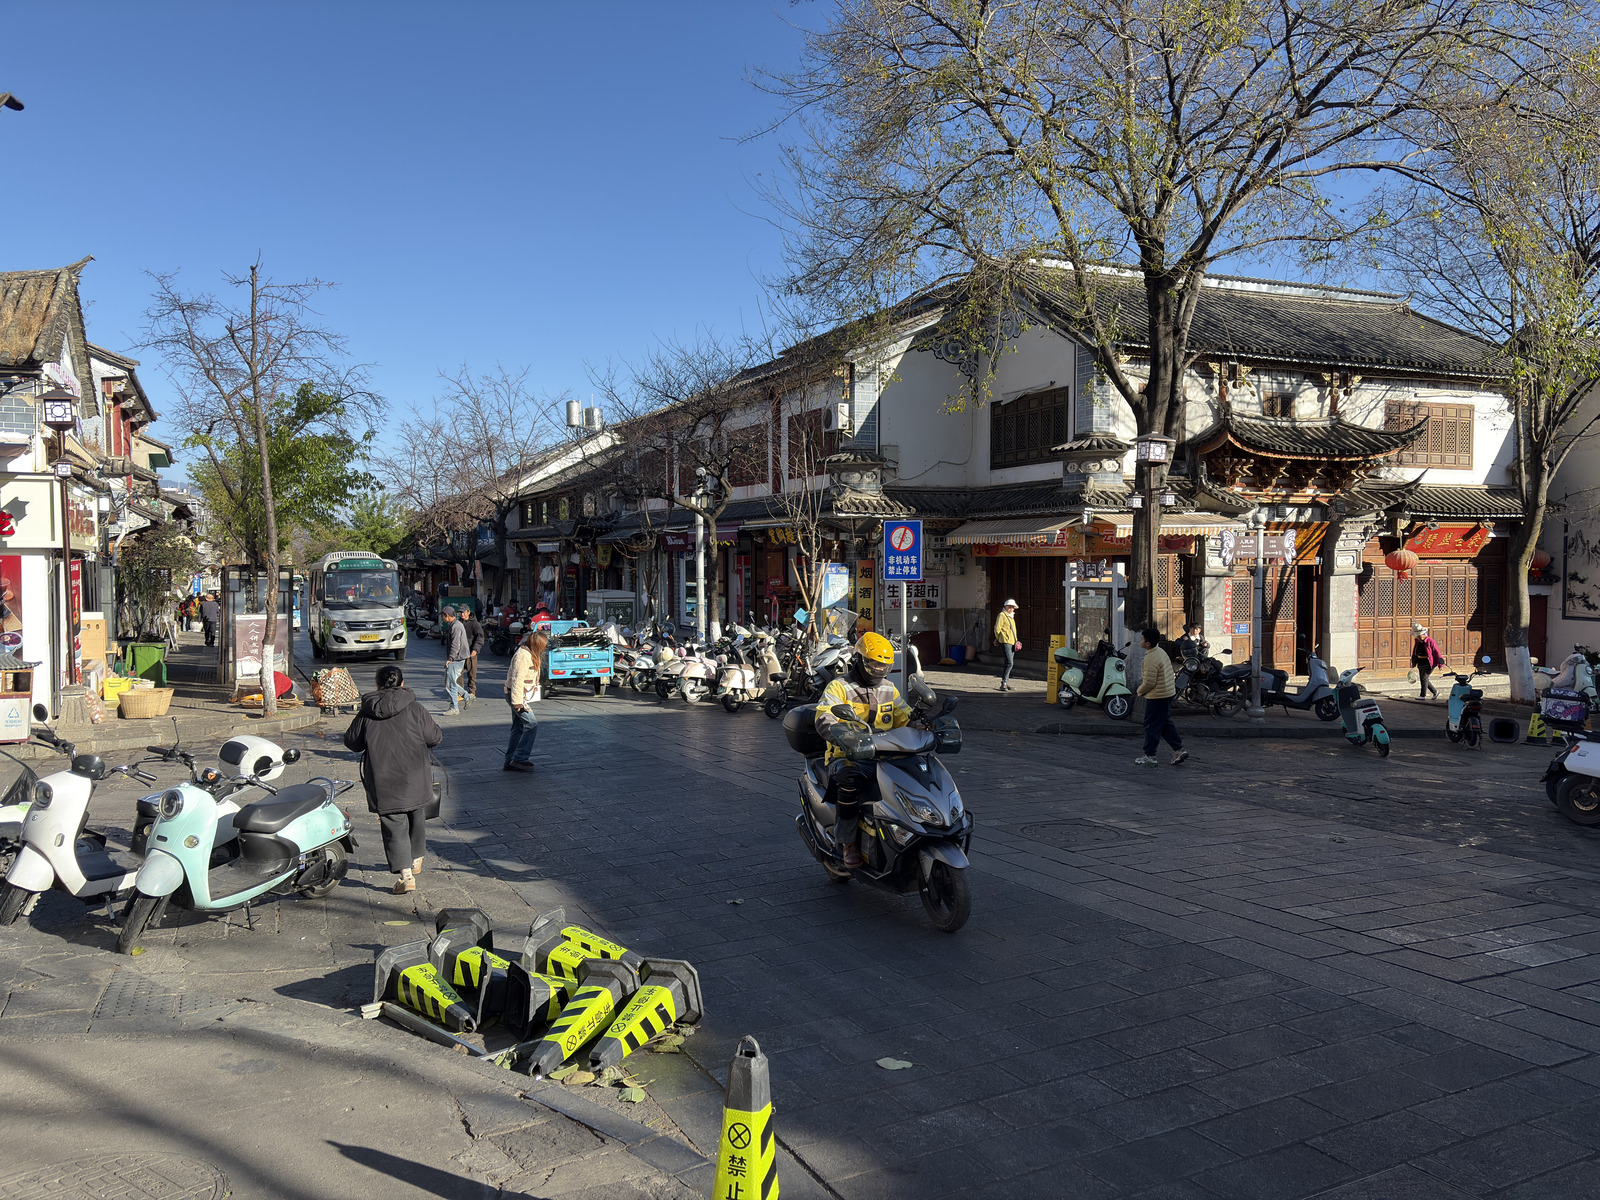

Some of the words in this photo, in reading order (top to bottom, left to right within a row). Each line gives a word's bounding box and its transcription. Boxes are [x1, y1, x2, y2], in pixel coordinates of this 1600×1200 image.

[888, 555, 917, 565] 非机动车
[888, 566, 917, 575] 禁止停放
[621, 988, 657, 1022] 禁止停车
[726, 1155, 747, 1200] 禁止
